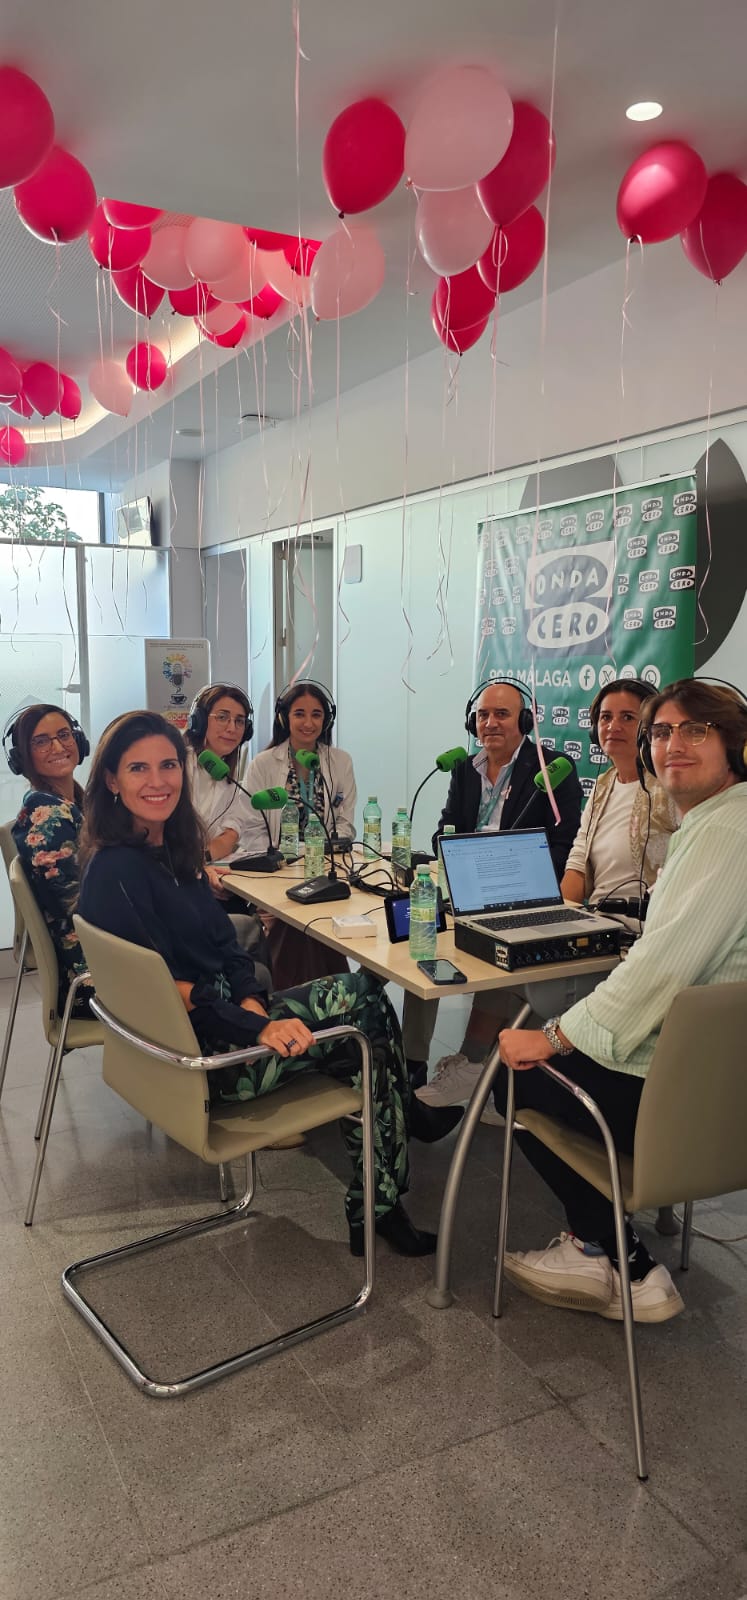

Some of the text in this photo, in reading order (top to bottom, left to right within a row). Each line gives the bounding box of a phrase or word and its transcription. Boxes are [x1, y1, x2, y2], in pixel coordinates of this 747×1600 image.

[671, 570, 692, 580] ONDA
[535, 567, 599, 596] ONDA
[672, 580, 692, 588] CERO
[655, 610, 674, 618] ONDA
[537, 612, 598, 640] CERO
[656, 619, 673, 628] CERO
